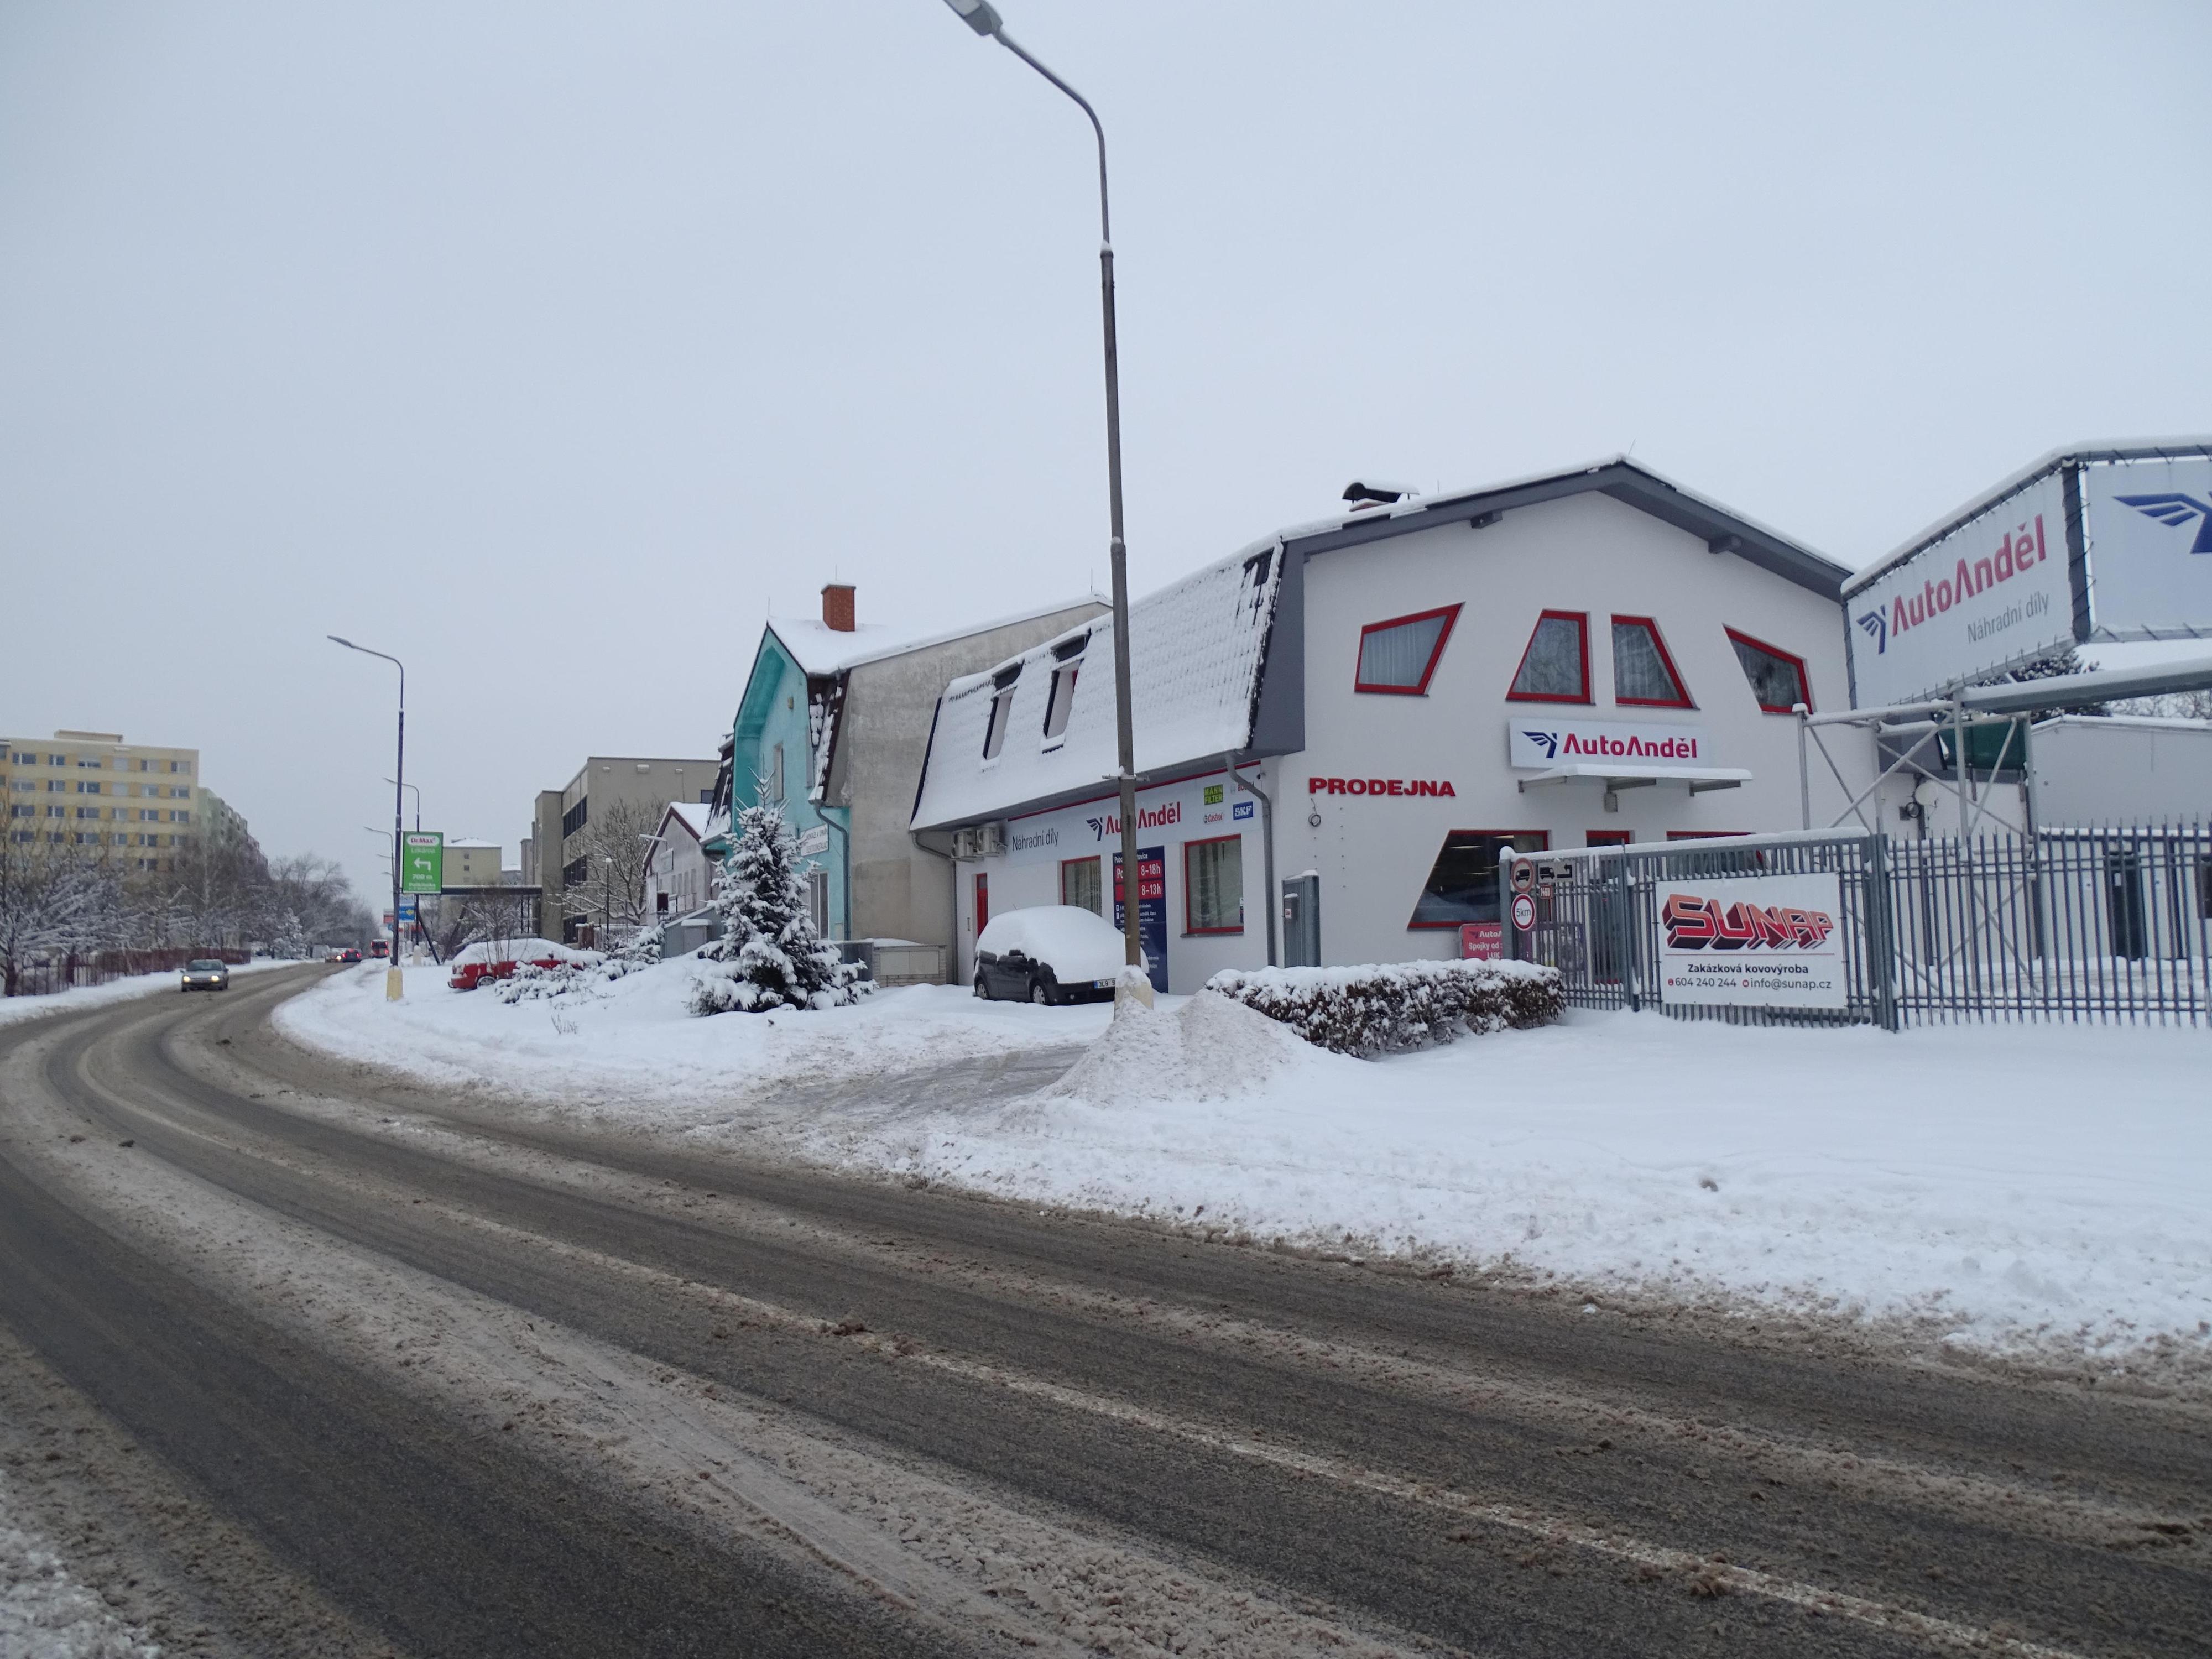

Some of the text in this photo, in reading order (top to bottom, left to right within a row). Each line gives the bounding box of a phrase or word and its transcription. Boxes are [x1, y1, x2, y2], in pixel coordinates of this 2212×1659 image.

[1892, 513, 2046, 637] AutoAnděl
[1967, 591, 2048, 643] Náhradní díly
[1562, 733, 1697, 758] AutoAnděl
[1204, 785, 1222, 796] MANN
[1308, 777, 1456, 797] PRODEJNA
[1205, 794, 1223, 805] FILTER
[1106, 801, 1181, 835] AuAnděl
[1208, 812, 1223, 823] Castrol
[1234, 805, 1252, 817] SKF
[1012, 828, 1058, 851] Náhradní díly
[1662, 894, 1834, 950] SUNAP
[1468, 942, 1490, 951] Spojky
[1687, 963, 1808, 974] Zakázková kovovýroba
[1675, 977, 1832, 990] 604 240 244 info@sunap.cz
